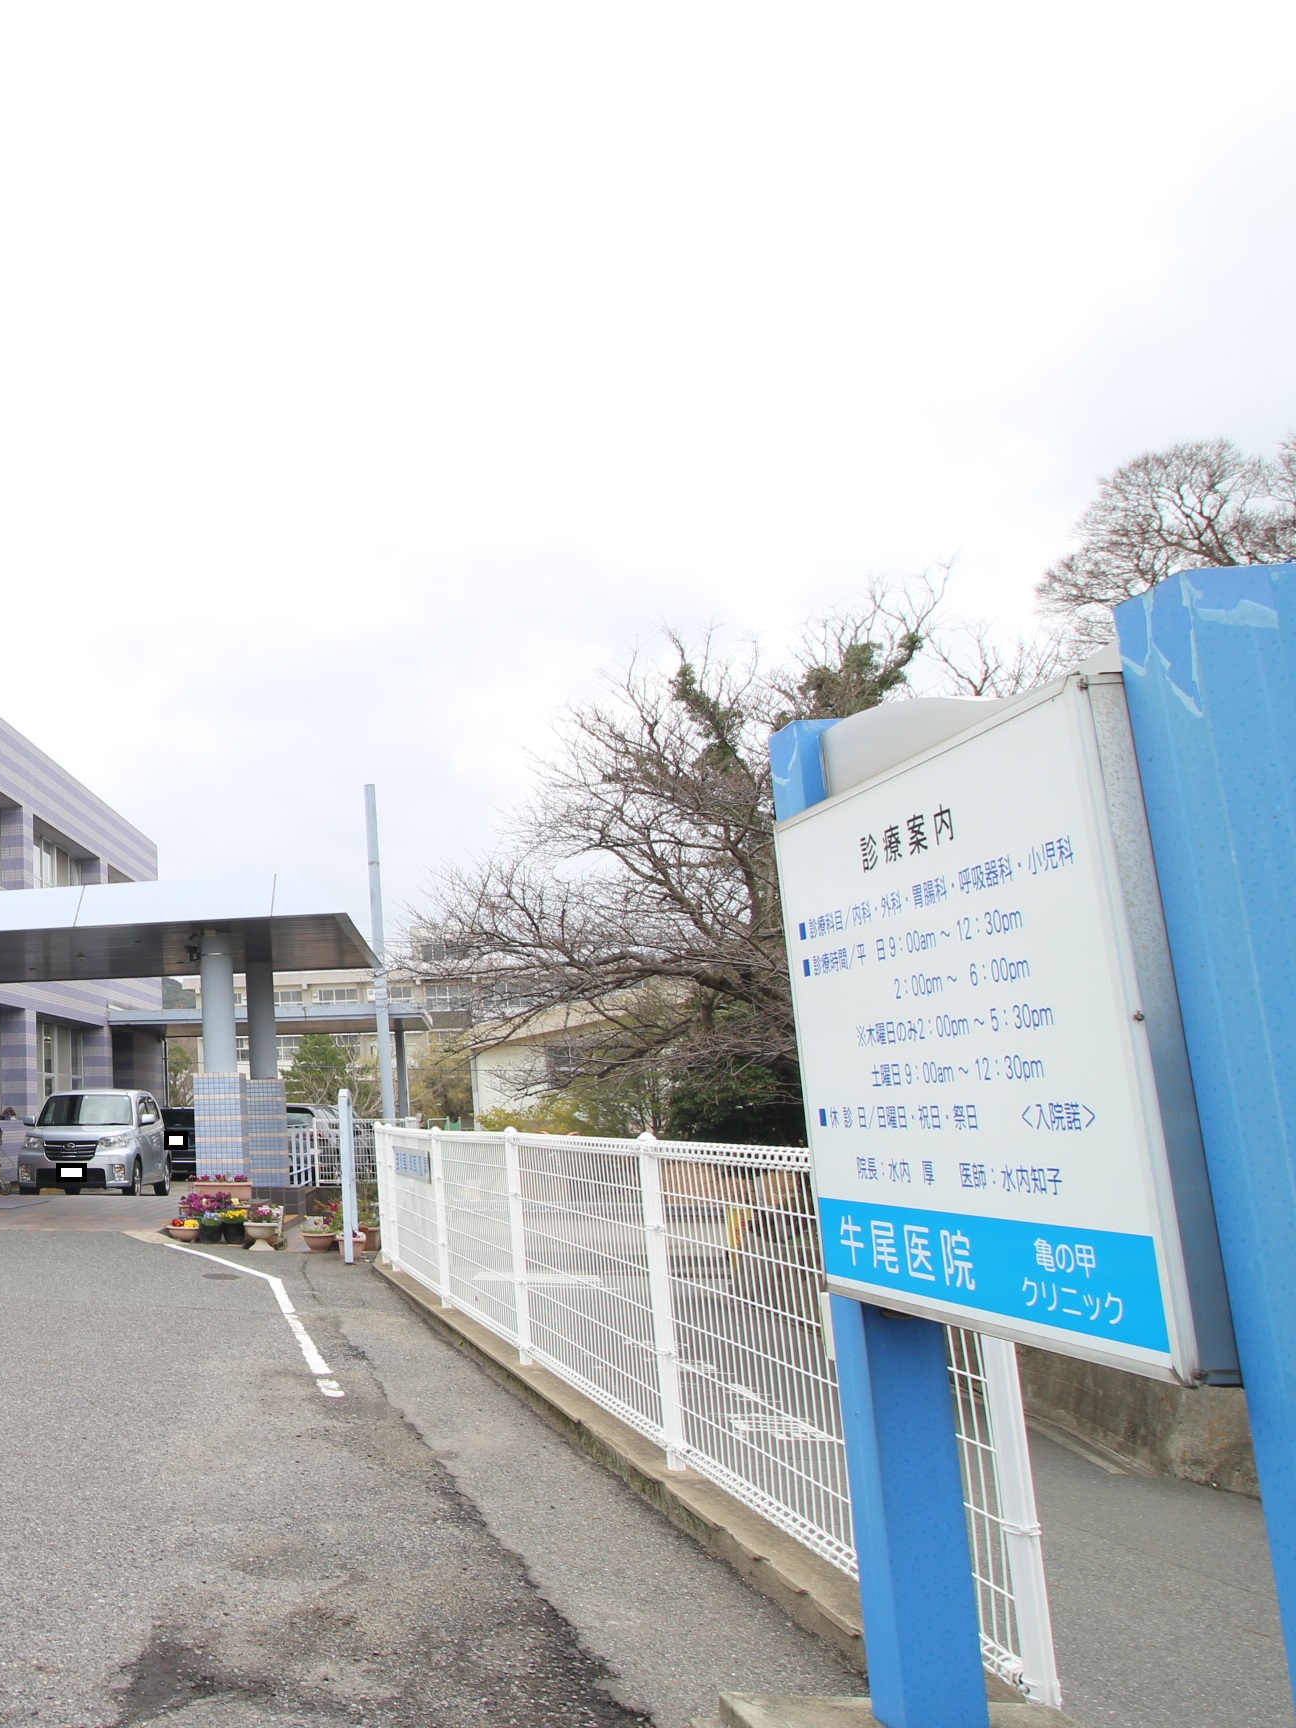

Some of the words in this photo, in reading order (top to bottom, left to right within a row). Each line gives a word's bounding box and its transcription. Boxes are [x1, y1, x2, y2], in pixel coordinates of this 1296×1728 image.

[860, 803, 954, 873] 診療案内
[839, 1214, 976, 1291] 牛尾医院
[1033, 1237, 1096, 1279] 亀の甲
[1022, 1276, 1124, 1325] クリニック
